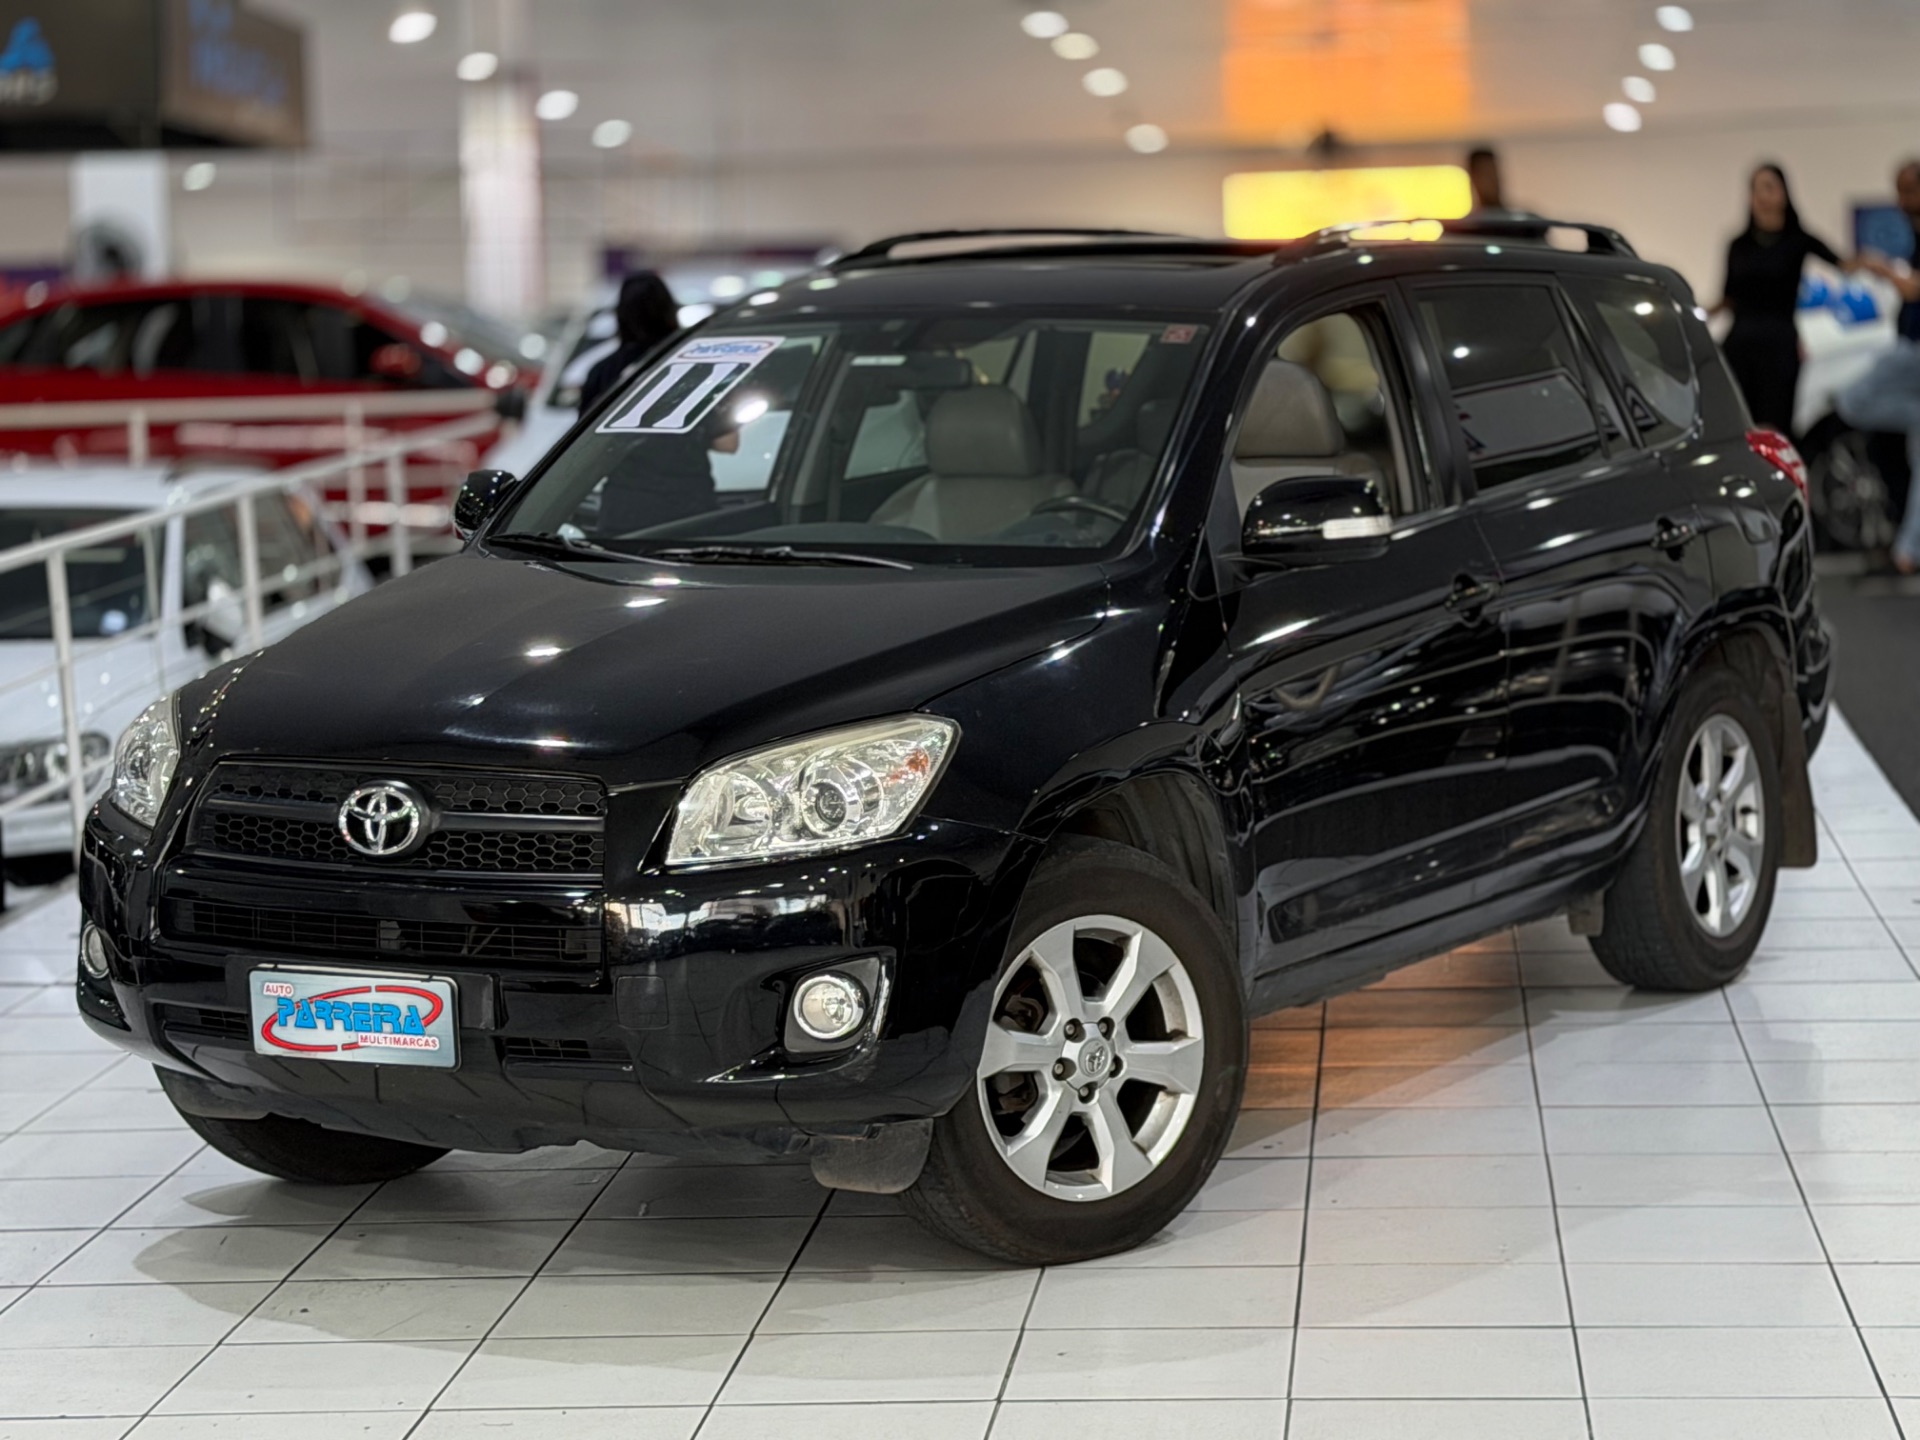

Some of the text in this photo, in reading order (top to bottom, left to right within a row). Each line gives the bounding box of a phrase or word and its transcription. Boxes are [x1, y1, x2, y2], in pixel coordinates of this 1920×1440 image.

[609, 362, 739, 428] 11
[265, 984, 293, 995] AUTO
[277, 997, 426, 1035] PARREIRA
[359, 1034, 439, 1048] MULTIMARCAS
